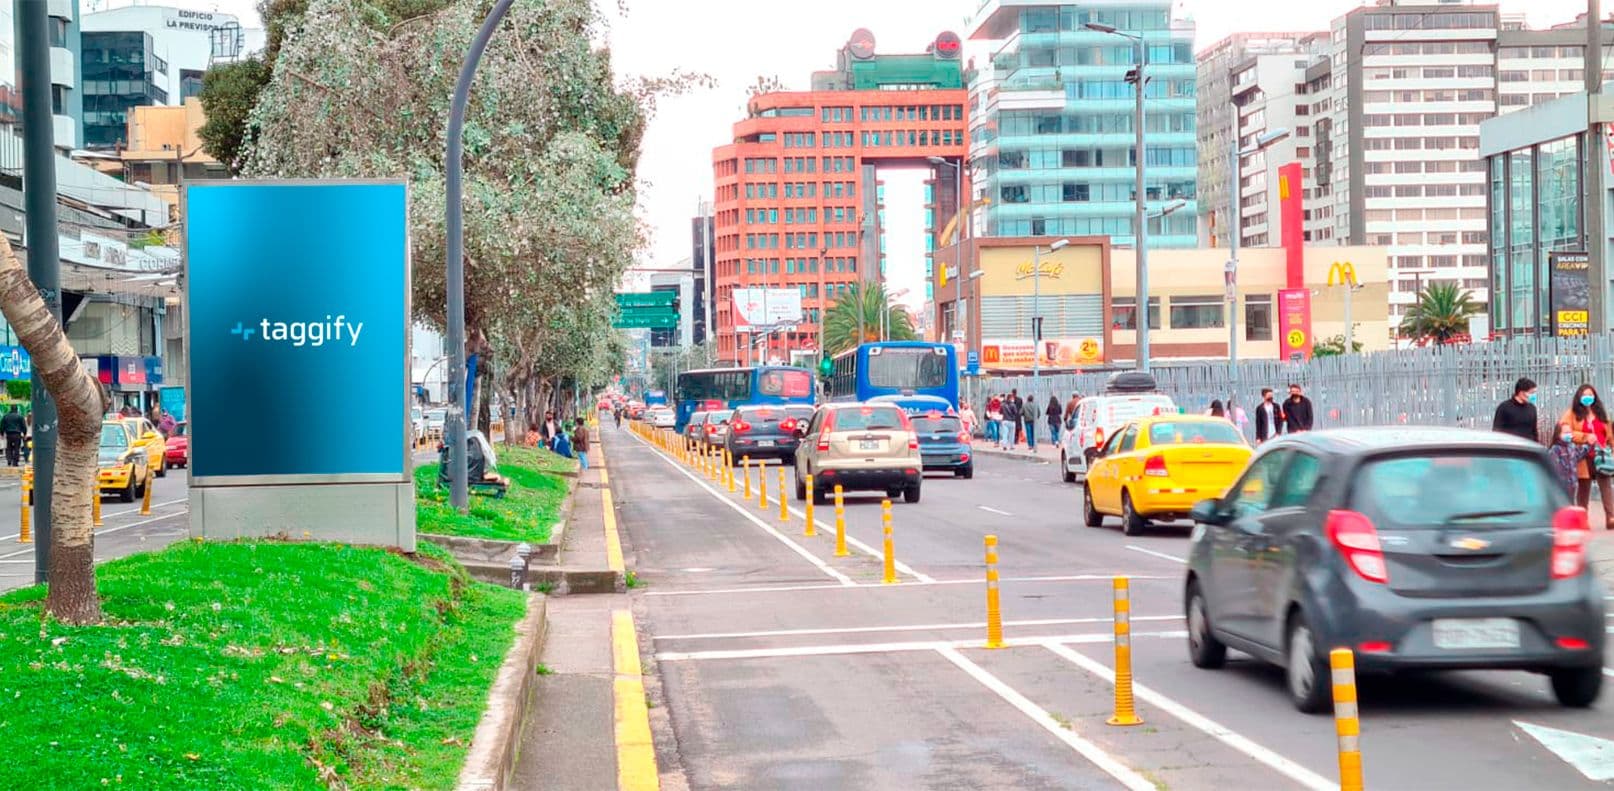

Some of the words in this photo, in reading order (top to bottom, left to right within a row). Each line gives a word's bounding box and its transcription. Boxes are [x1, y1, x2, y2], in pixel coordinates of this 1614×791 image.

[178, 10, 213, 20] EDIFICIO
[166, 20, 177, 28] LA
[1563, 313, 1583, 322] CCI
[260, 315, 363, 346] taggify
